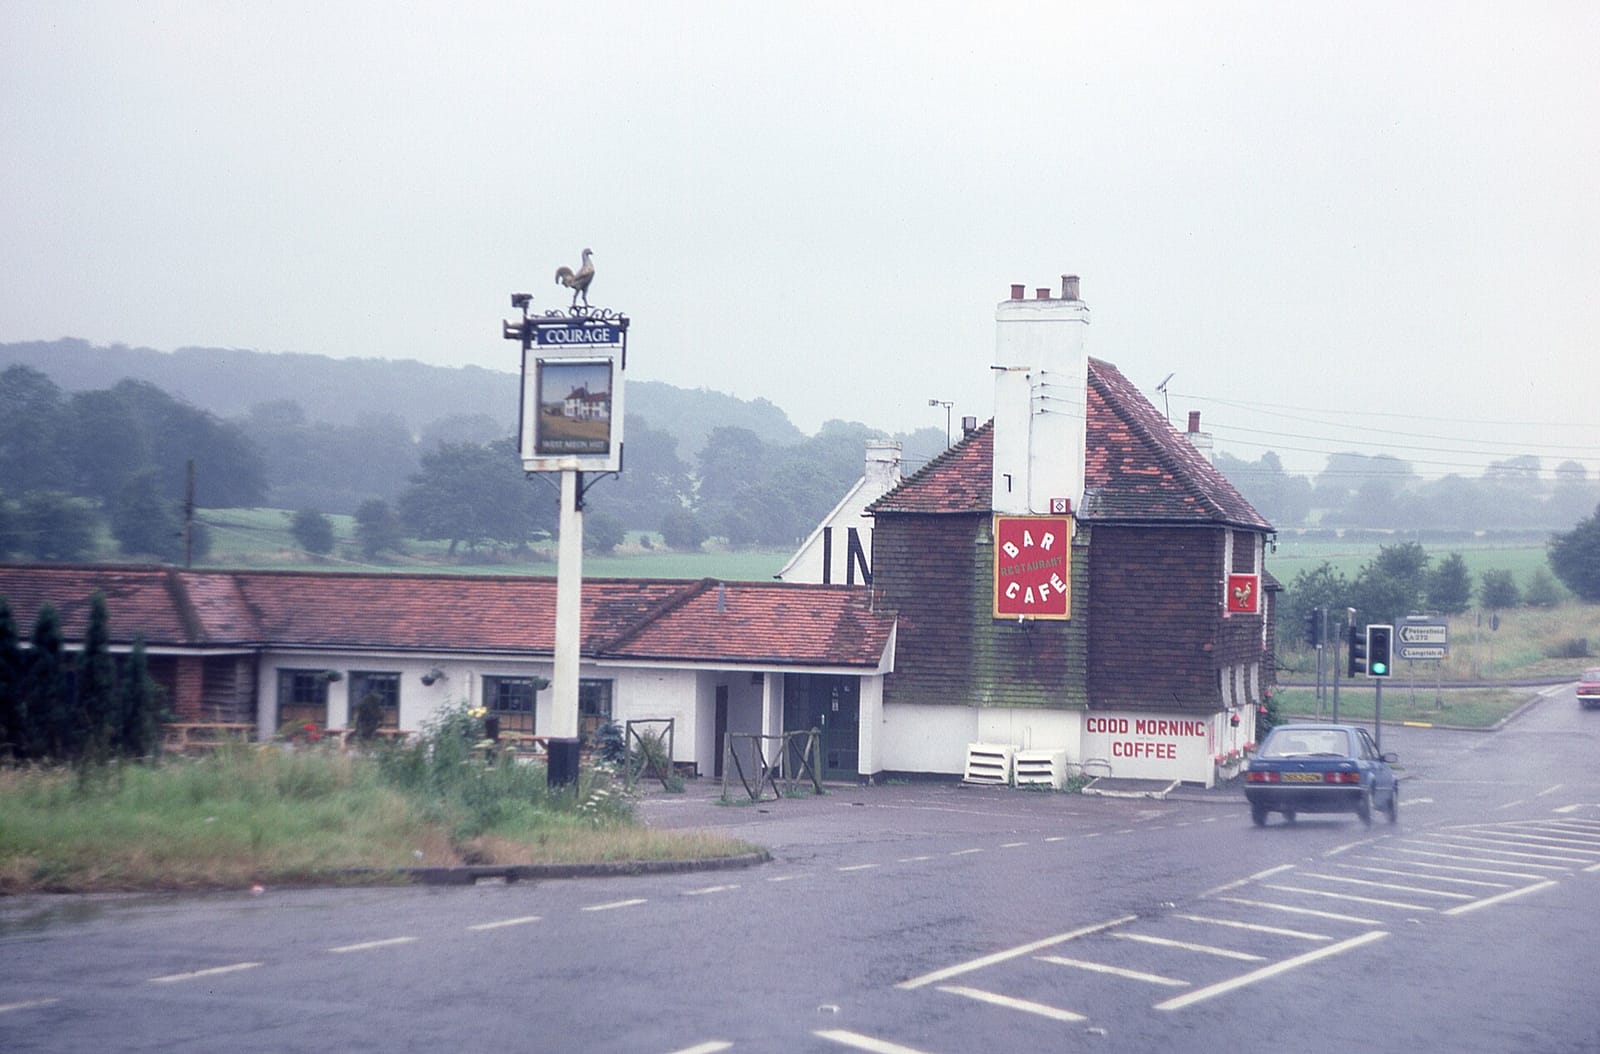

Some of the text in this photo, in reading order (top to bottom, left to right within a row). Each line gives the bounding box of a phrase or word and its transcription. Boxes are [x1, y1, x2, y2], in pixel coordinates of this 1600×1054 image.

[545, 328, 610, 343] COURAGE
[1002, 530, 1055, 559] BAR
[1001, 557, 1063, 577] RESTAURANT
[1005, 572, 1067, 604] CAFE
[1135, 719, 1205, 737] MORNING
[1112, 742, 1177, 759] COFFEE
